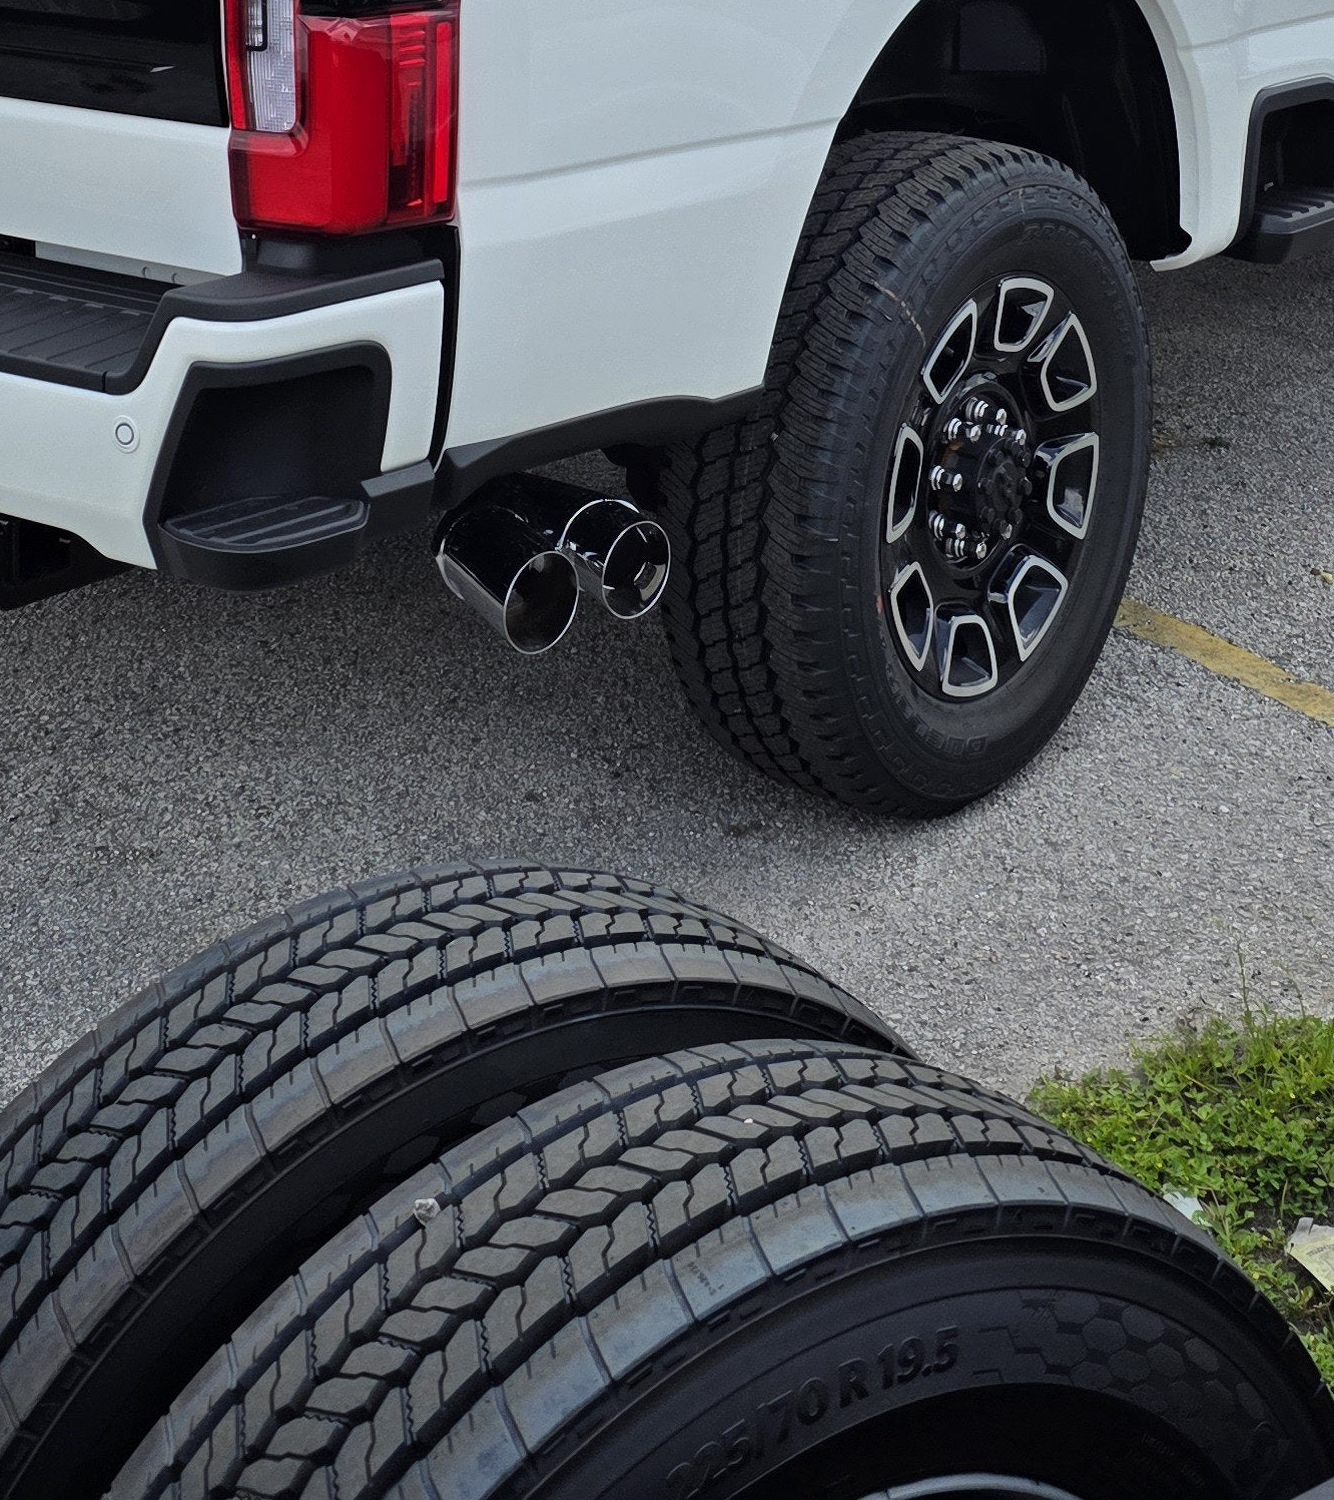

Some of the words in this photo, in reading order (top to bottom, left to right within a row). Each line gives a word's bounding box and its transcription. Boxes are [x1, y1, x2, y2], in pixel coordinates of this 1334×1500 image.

[666, 1375, 829, 1500] 225/70
[837, 1357, 869, 1408] R
[876, 1325, 960, 1391] 19.5
